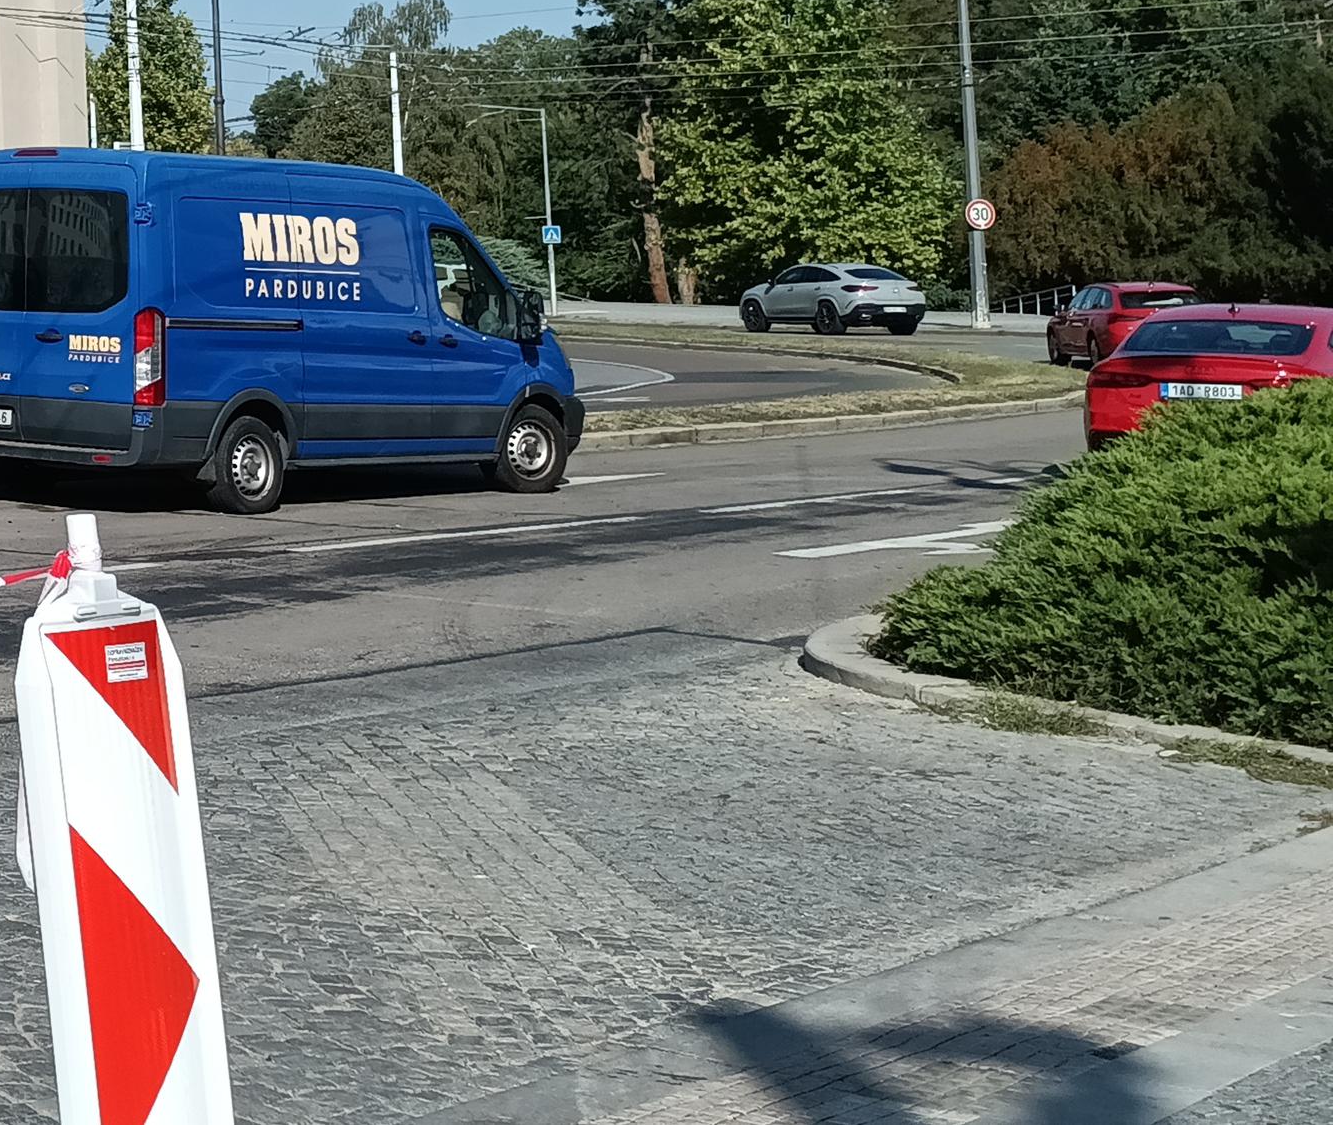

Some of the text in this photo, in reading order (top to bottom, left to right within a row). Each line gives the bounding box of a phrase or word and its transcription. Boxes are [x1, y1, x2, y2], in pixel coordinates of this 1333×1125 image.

[973, 207, 989, 221] 30
[240, 212, 360, 266] MIROS
[245, 278, 361, 301] PARDUBICE
[68, 334, 121, 353] MIROS
[67, 353, 121, 364] PARDUBICE
[1172, 385, 1194, 396] 1AD
